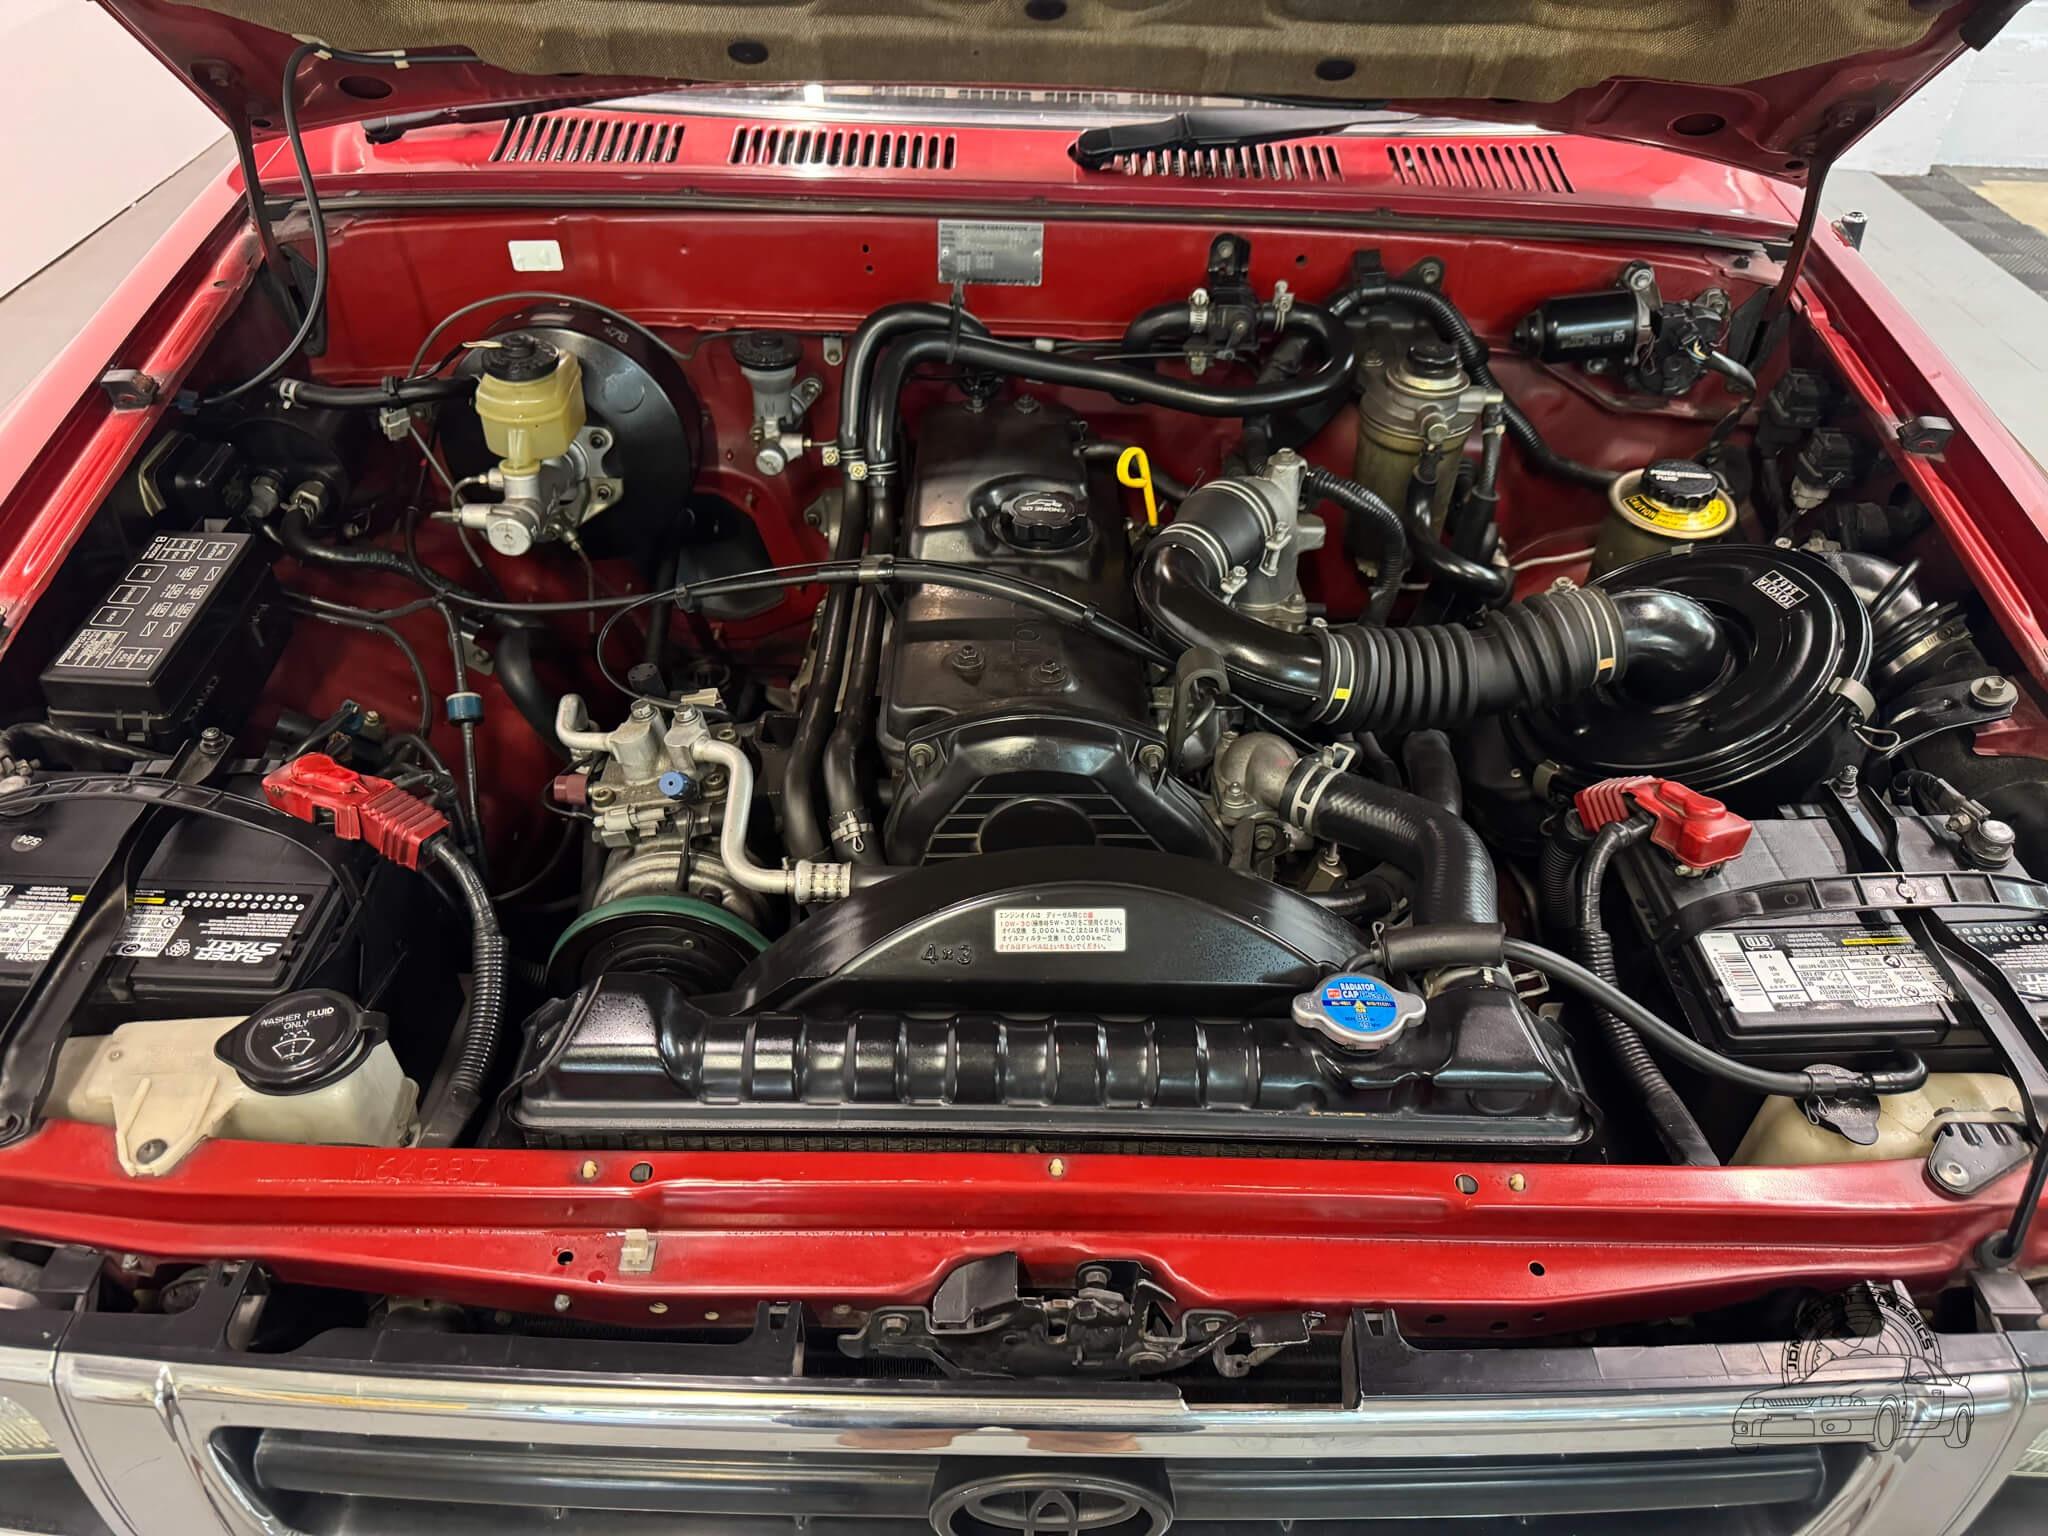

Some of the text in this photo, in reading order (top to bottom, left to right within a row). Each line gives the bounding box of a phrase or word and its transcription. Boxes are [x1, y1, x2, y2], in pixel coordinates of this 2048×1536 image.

[1627, 497, 1657, 520] CAUTION
[1757, 579, 1794, 607] TOYOTA
[205, 940, 281, 955] START
[1746, 936, 1769, 947] STD
[193, 949, 264, 964] SUPER
[1340, 982, 1375, 991] RADIATOR
[1342, 990, 1359, 999] CAP
[261, 1007, 335, 1027] WASHER FLUID
[283, 1018, 309, 1030] ONLY
